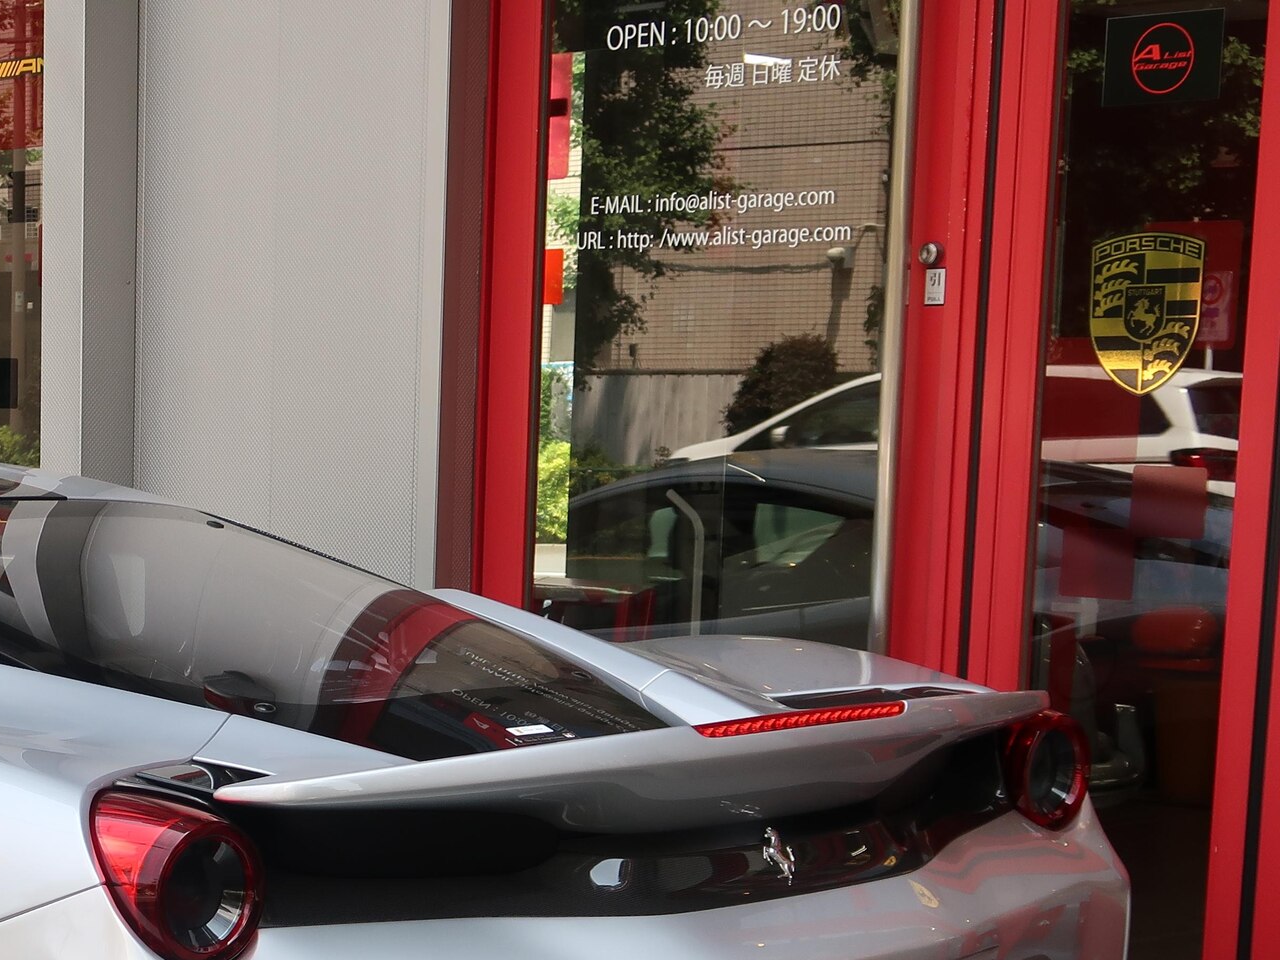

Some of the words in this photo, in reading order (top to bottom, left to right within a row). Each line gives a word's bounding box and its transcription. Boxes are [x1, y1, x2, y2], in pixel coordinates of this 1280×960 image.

[606, 20, 666, 51] OPEN
[684, 13, 742, 44] 10:00
[781, 3, 842, 35] 19:00
[1133, 44, 1161, 62] A
[1134, 61, 1187, 71] Garage
[590, 195, 644, 216] E-MAIL
[655, 189, 835, 214] info@alist-garage.com
[576, 231, 606, 251] URL
[1096, 237, 1200, 262] PORSCHE
[1127, 287, 1163, 297] STUTTGART
